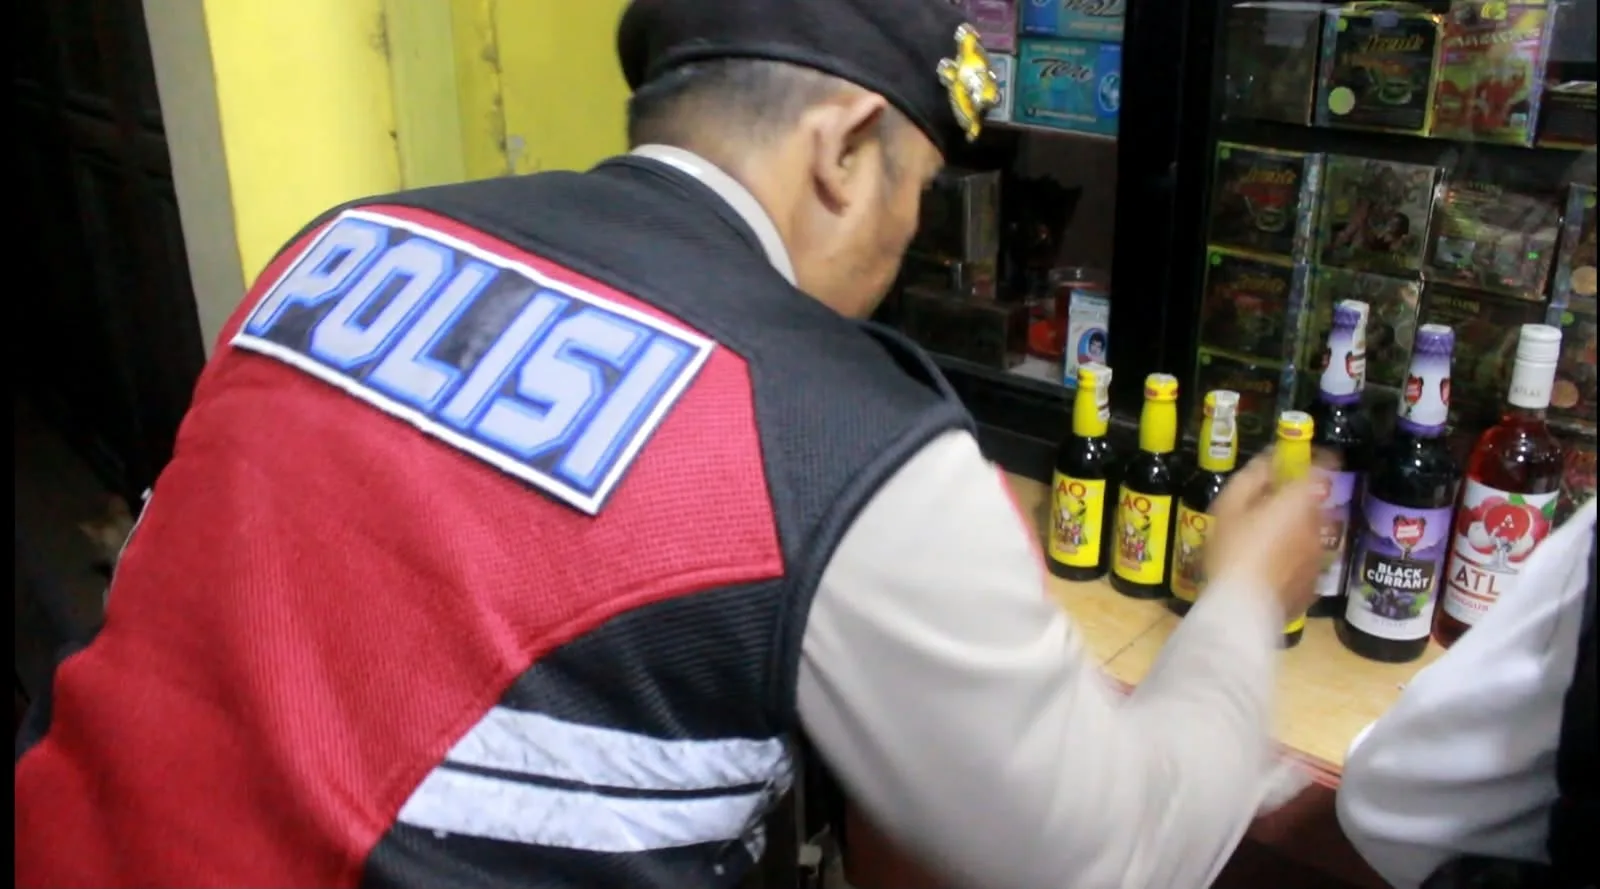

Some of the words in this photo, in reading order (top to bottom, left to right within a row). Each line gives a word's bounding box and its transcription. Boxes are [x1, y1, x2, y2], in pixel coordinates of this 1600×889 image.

[248, 218, 681, 492] POLISI
[1367, 569, 1429, 589] CURRANT
[1377, 562, 1422, 579] BLACK
[1455, 565, 1500, 595] ATL
